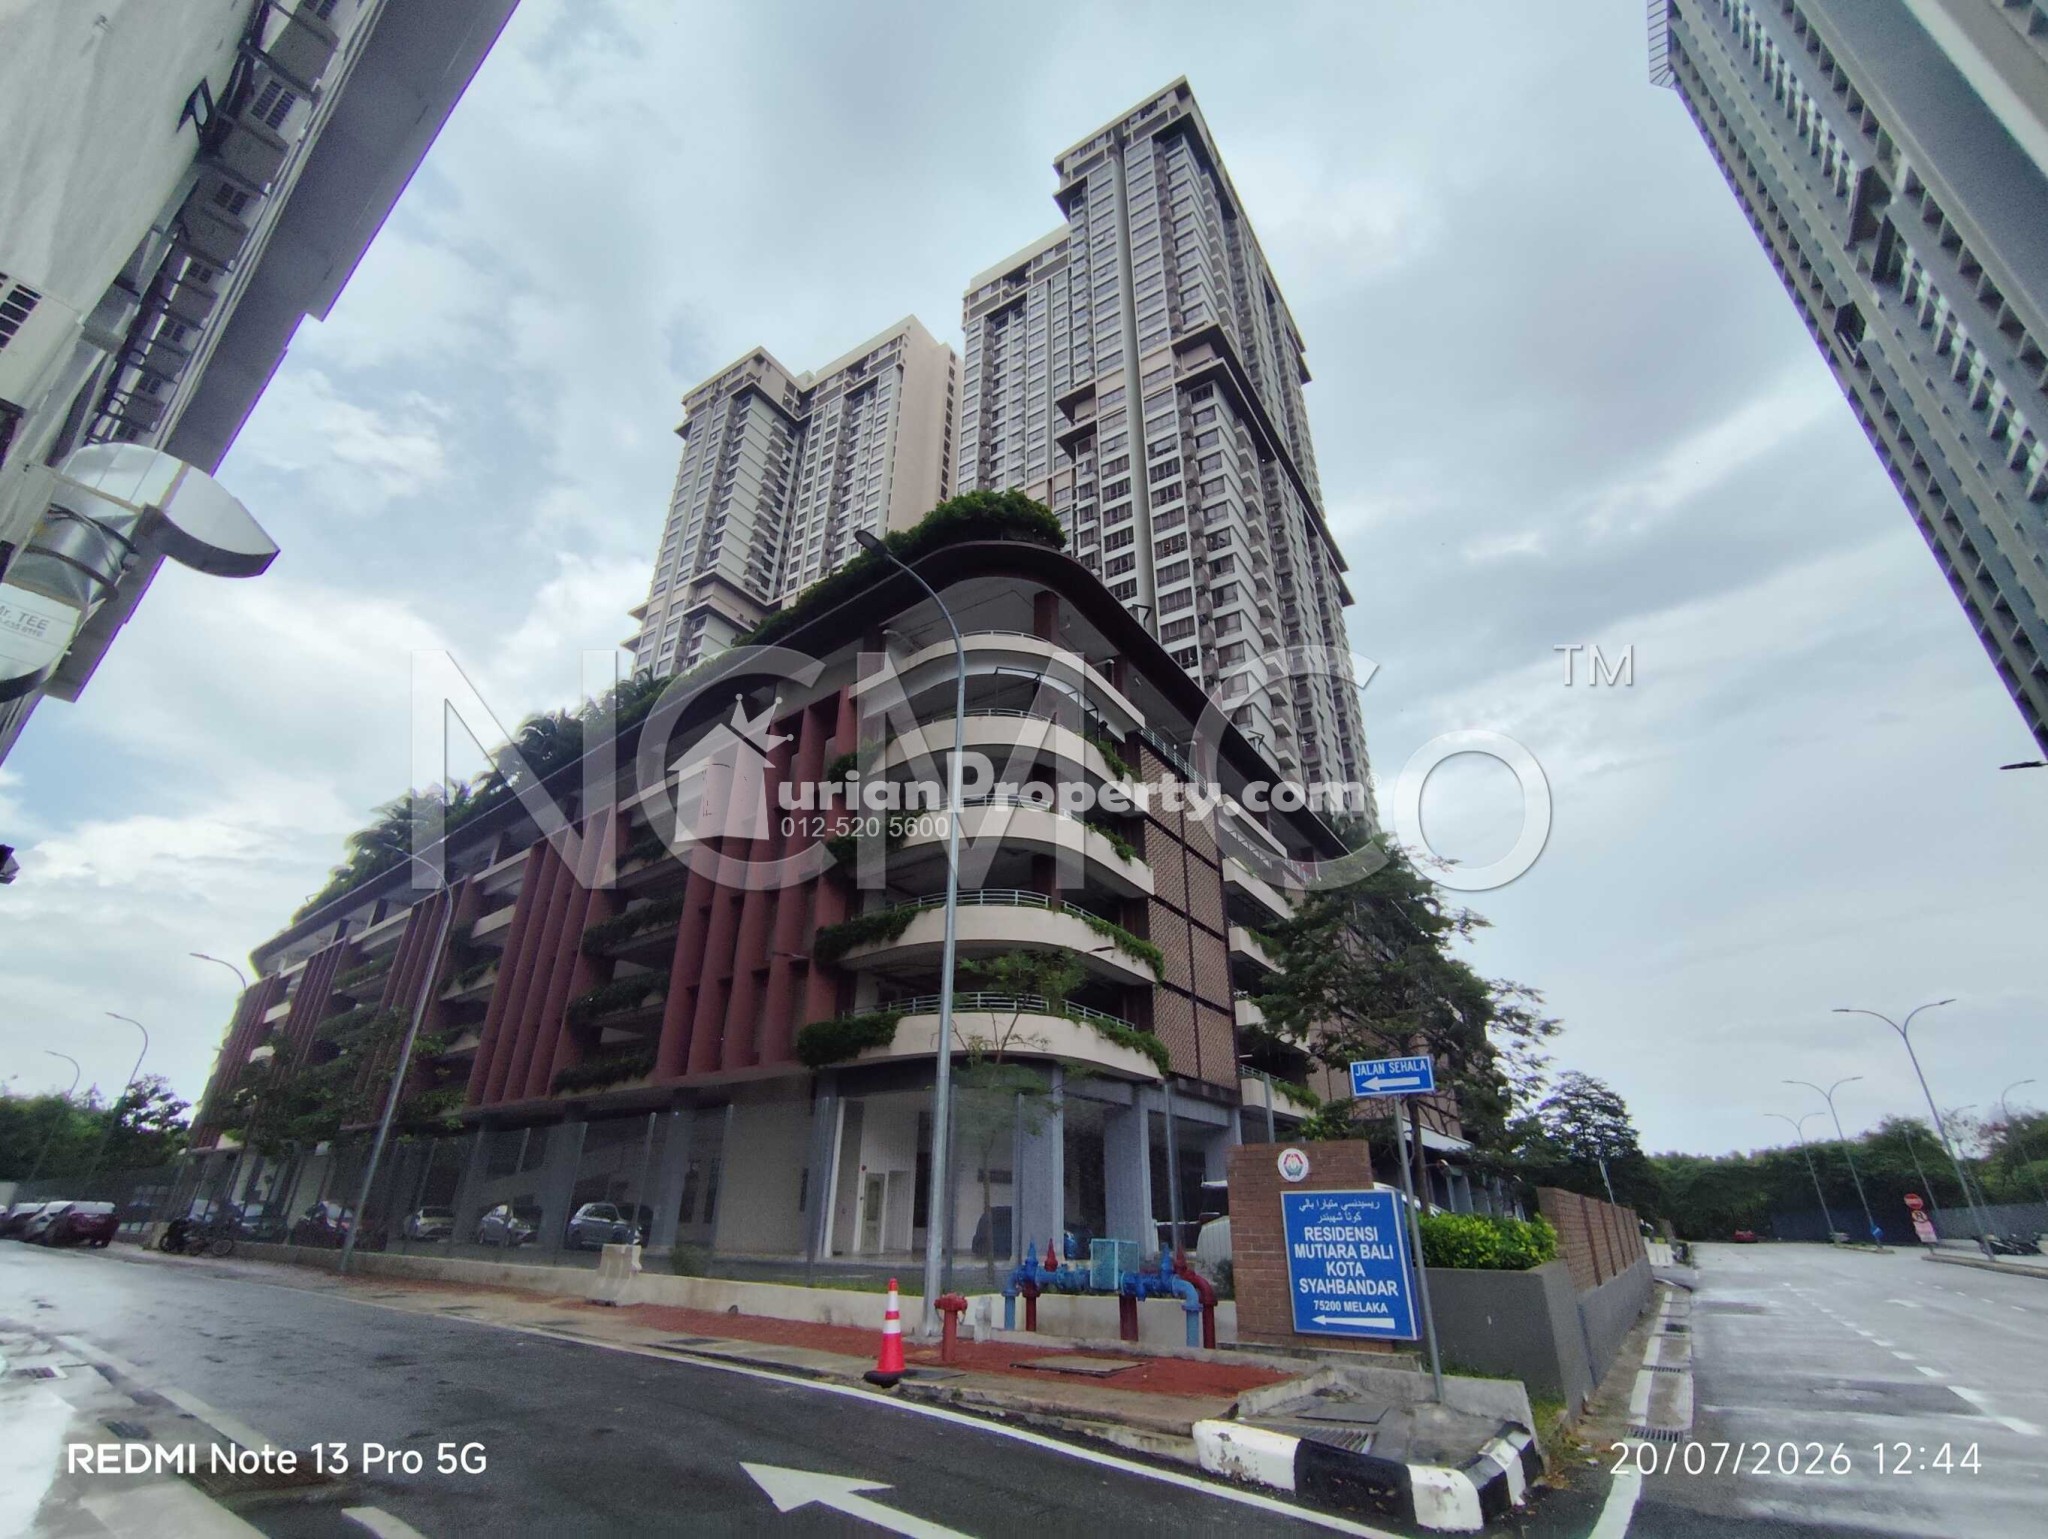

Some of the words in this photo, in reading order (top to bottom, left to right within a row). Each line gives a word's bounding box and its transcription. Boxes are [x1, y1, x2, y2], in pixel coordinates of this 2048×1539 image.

[18, 611, 50, 631] TEE
[1355, 1062, 1386, 1077] JALAN
[1388, 1060, 1427, 1074] SEHALA
[1304, 1226, 1379, 1242] RESIDENSI
[1294, 1243, 1358, 1259] MUTIARA
[1360, 1244, 1394, 1260] BALI
[1326, 1261, 1366, 1277] KOTA
[1299, 1278, 1399, 1296] SYAHBANDAR
[1313, 1300, 1341, 1312] 75200
[1343, 1301, 1389, 1313] MELAKA
